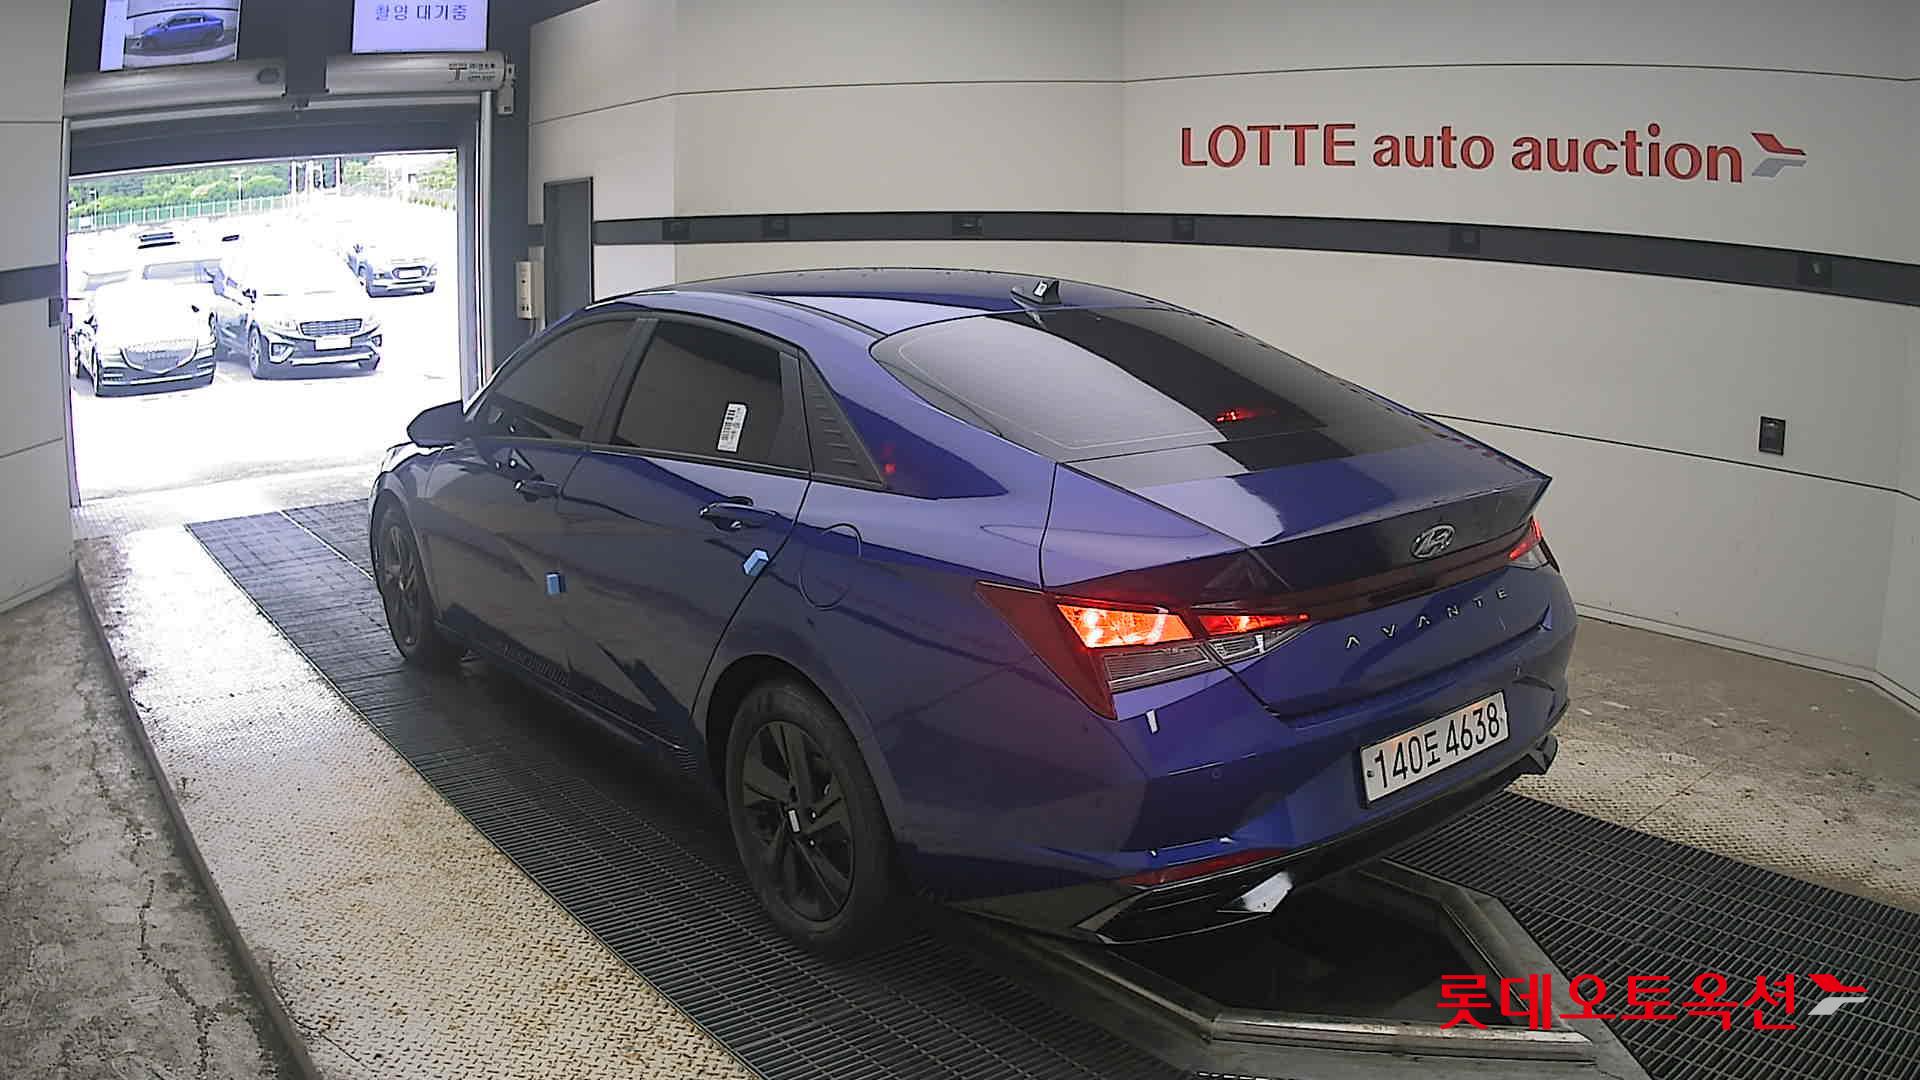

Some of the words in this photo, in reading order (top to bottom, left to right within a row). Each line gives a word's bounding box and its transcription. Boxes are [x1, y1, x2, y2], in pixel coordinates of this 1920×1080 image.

[416, 4, 467, 21] 대기중
[1180, 123, 1356, 168] LOTTE
[1372, 126, 1495, 170] auto
[1511, 123, 1744, 184] auction
[1346, 588, 1507, 649] AVANTE
[1374, 730, 1441, 788] 140도
[1445, 702, 1500, 756] 4638
